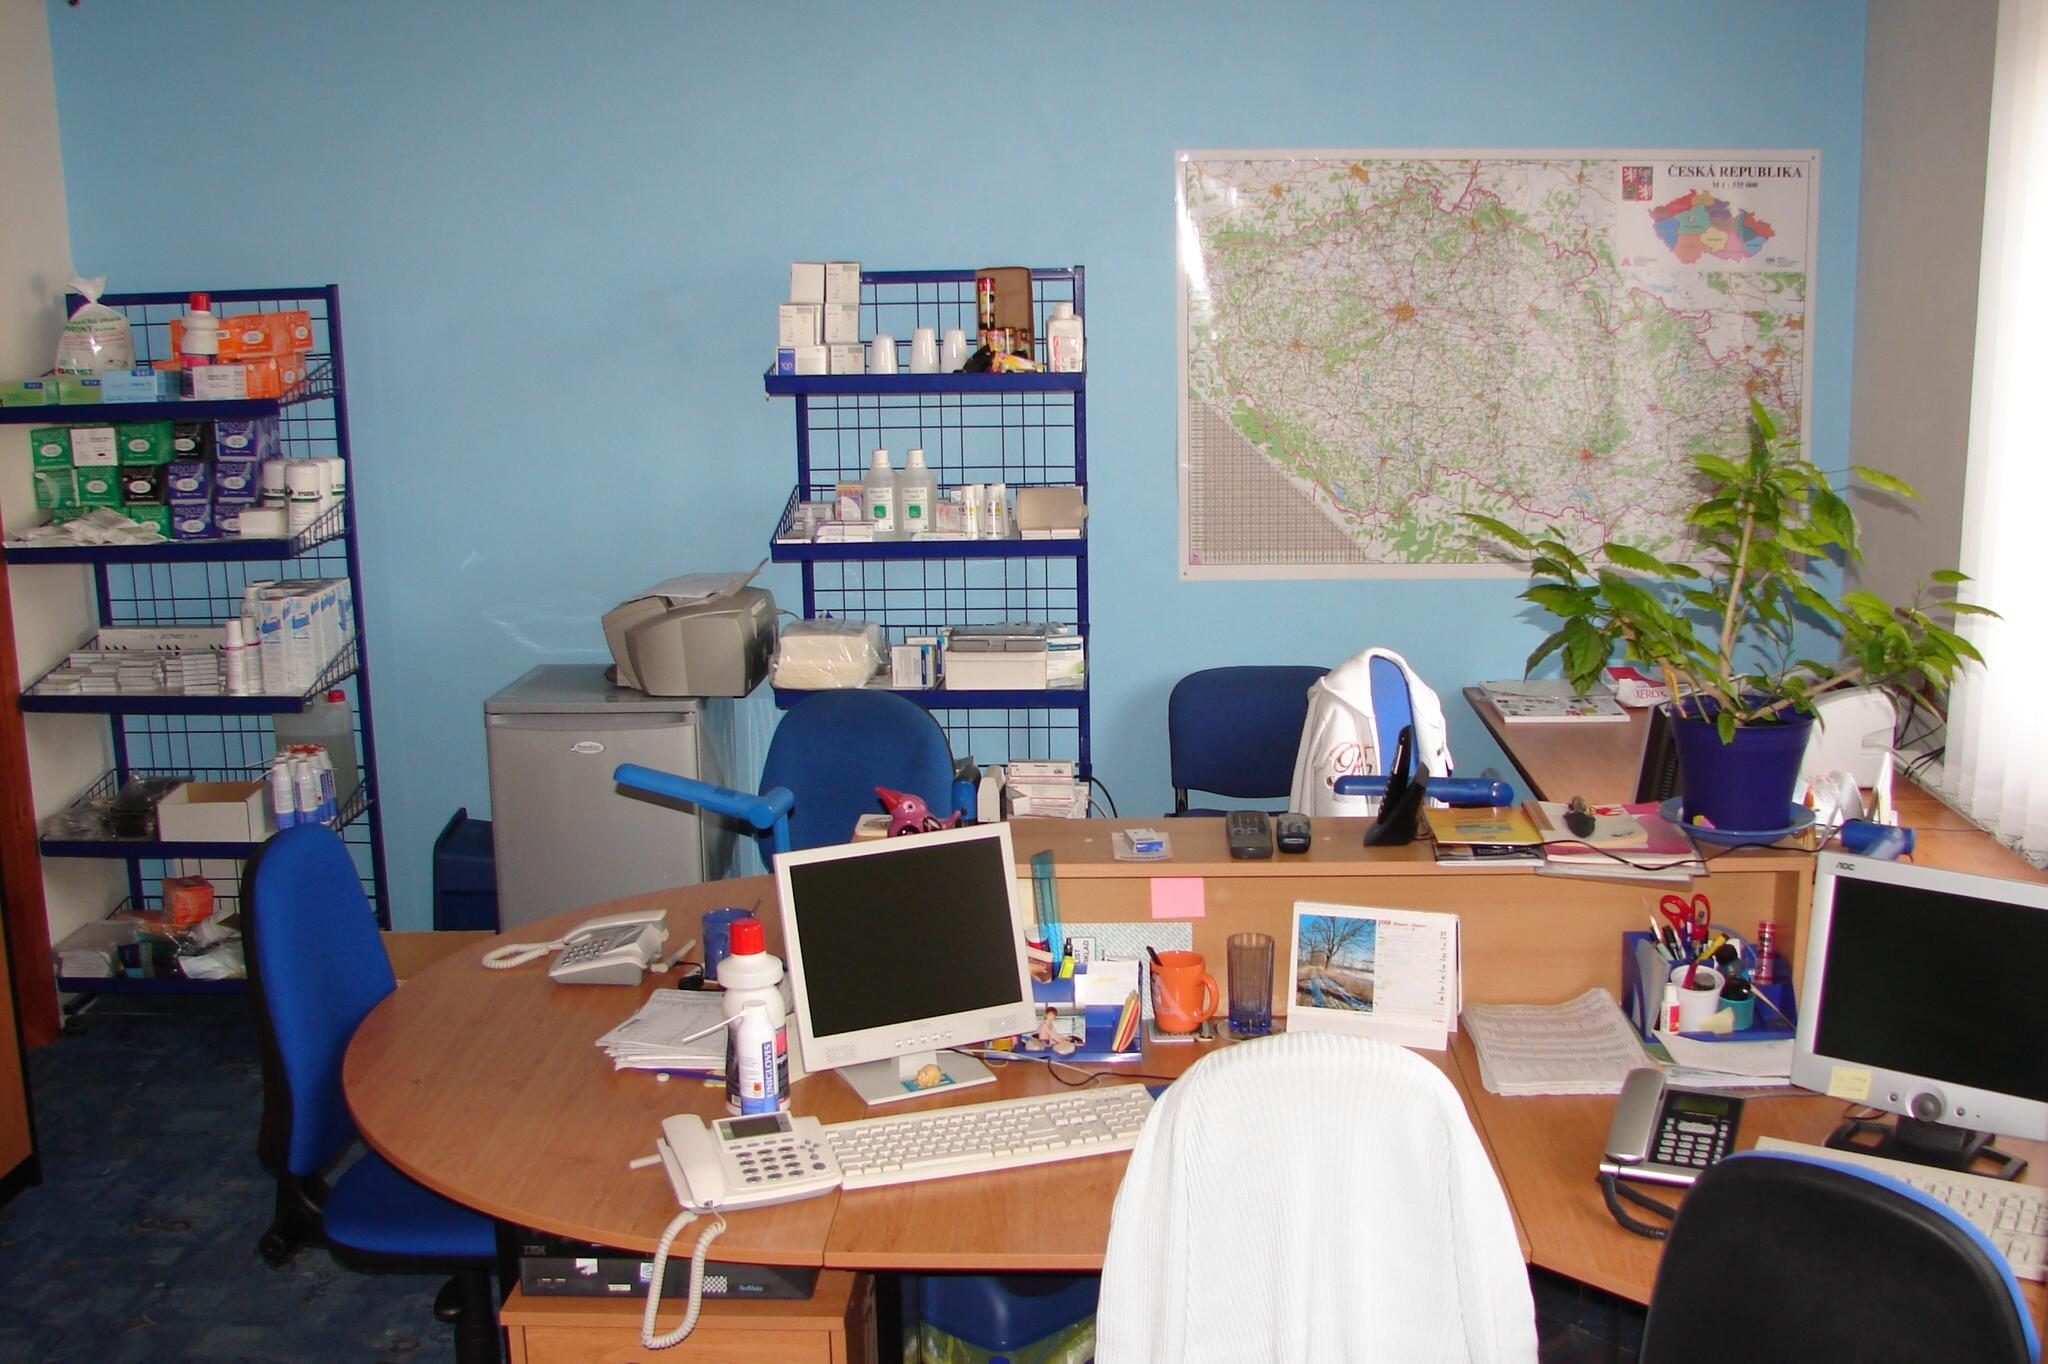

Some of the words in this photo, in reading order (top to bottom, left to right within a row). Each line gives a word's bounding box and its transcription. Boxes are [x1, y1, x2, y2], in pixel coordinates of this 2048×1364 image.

[1667, 164, 1715, 178] ČESKÁ
[1719, 166, 1802, 178] REPUBLIKA
[1636, 688, 1665, 698] XEROX
[1835, 862, 1855, 871] AOC
